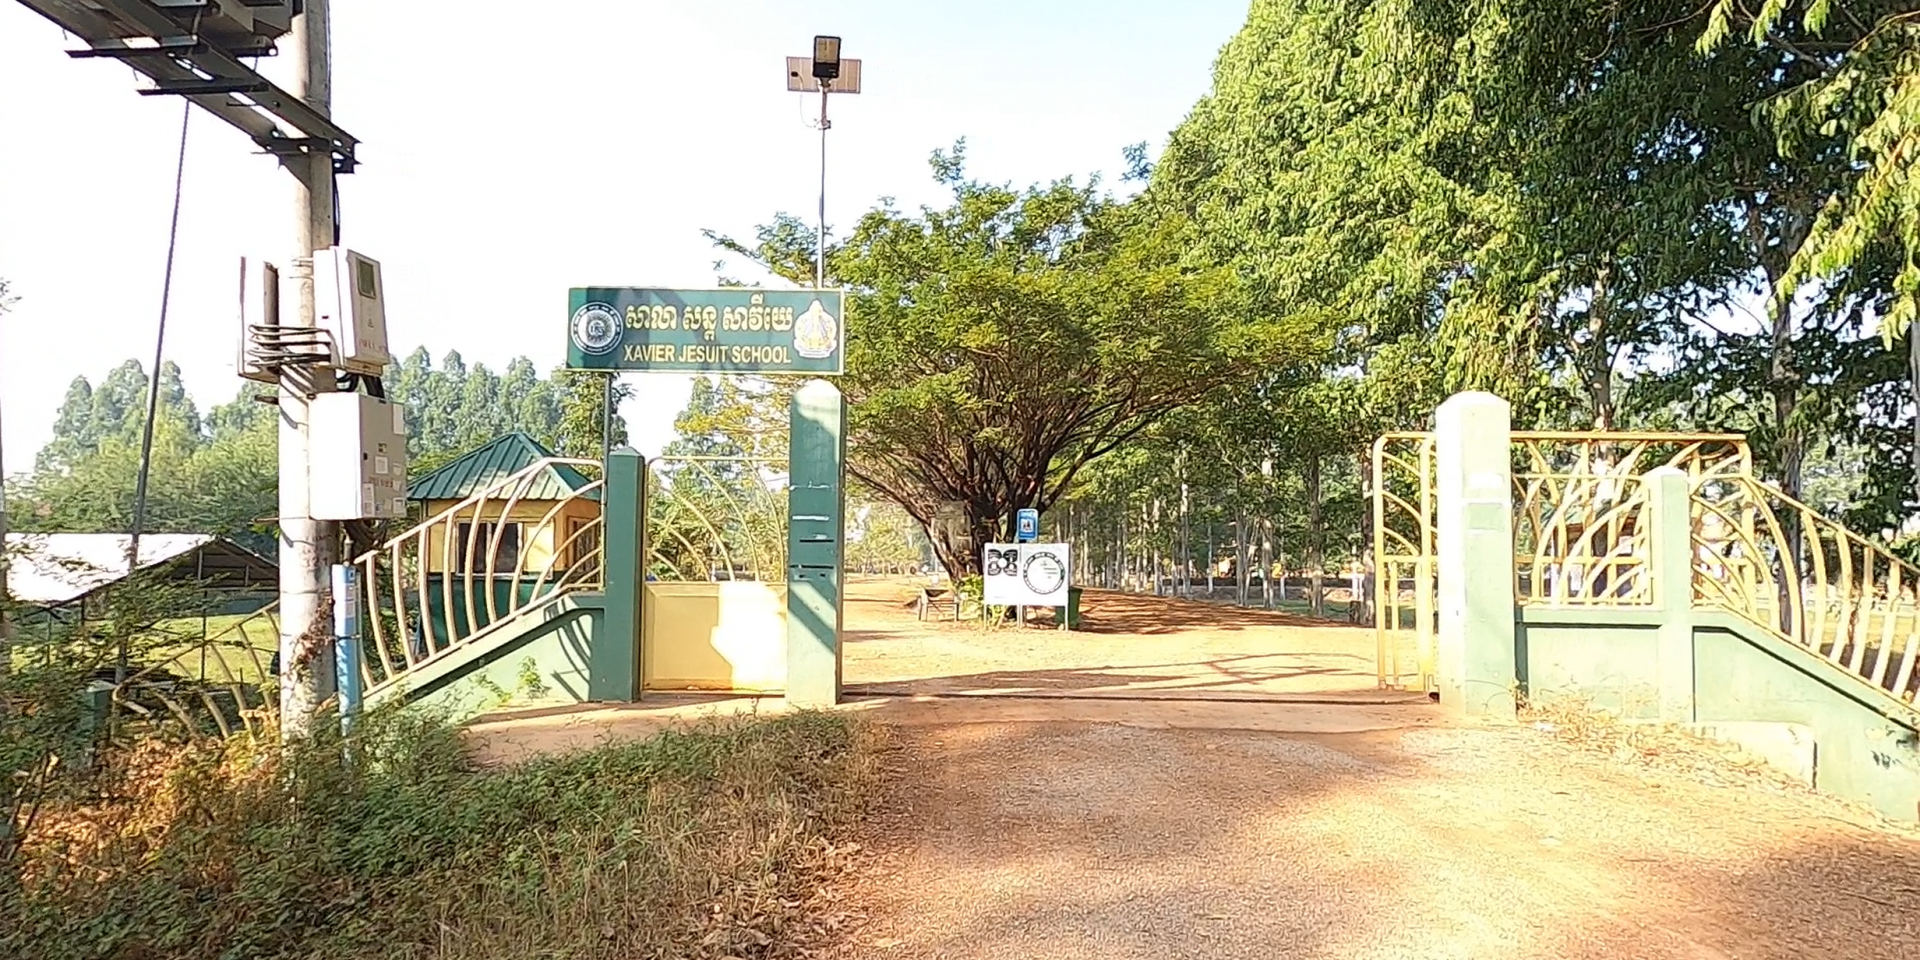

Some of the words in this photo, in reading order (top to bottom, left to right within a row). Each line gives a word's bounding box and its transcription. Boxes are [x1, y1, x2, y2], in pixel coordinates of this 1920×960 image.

[626, 304, 677, 330] សាលា
[624, 344, 675, 362] XAVIER
[678, 345, 728, 363] JESUIT
[731, 346, 791, 364] SCHOOL
